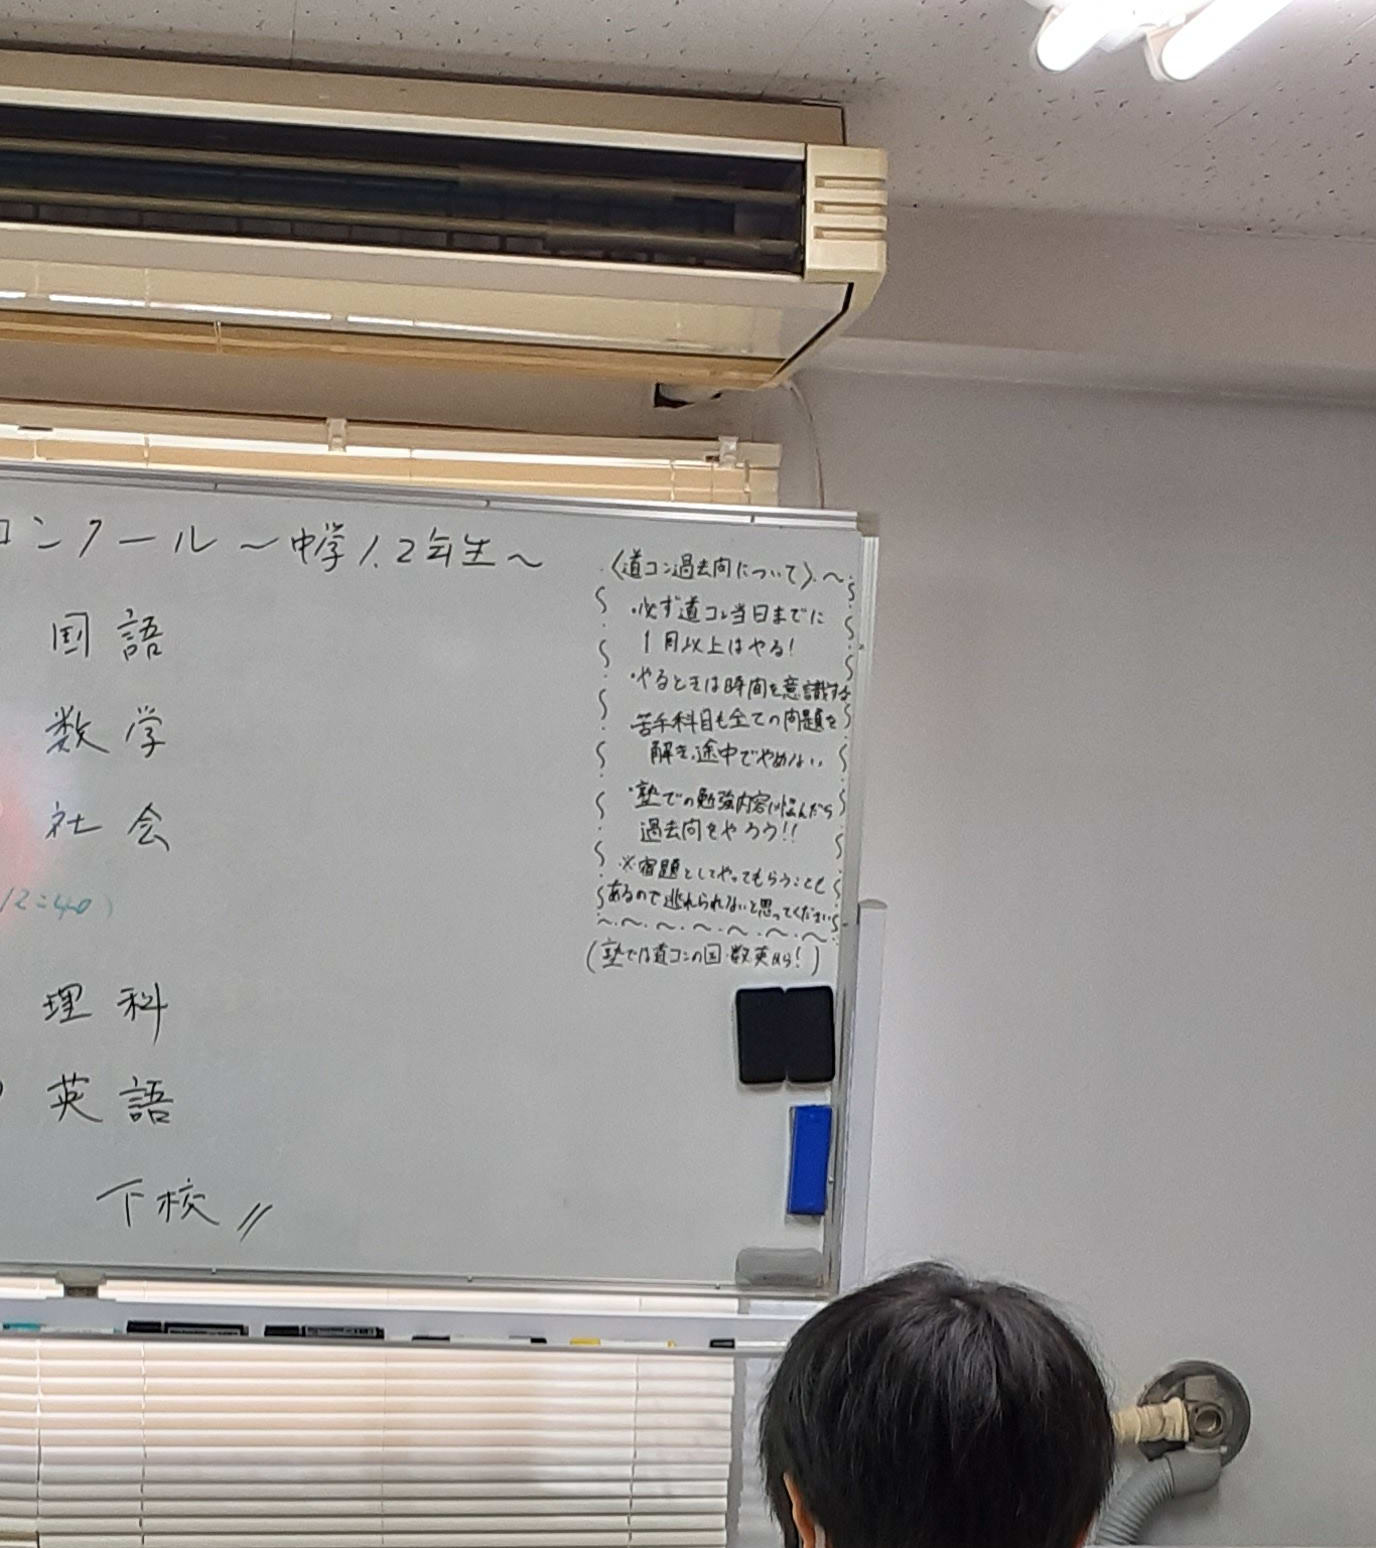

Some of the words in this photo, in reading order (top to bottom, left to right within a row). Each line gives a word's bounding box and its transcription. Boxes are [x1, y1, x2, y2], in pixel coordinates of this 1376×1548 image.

[49, 609, 165, 662] 国語
[45, 704, 169, 758] 数学
[44, 802, 170, 852] 社会
[42, 982, 169, 1044] 理科
[49, 1073, 174, 1125] 英語
